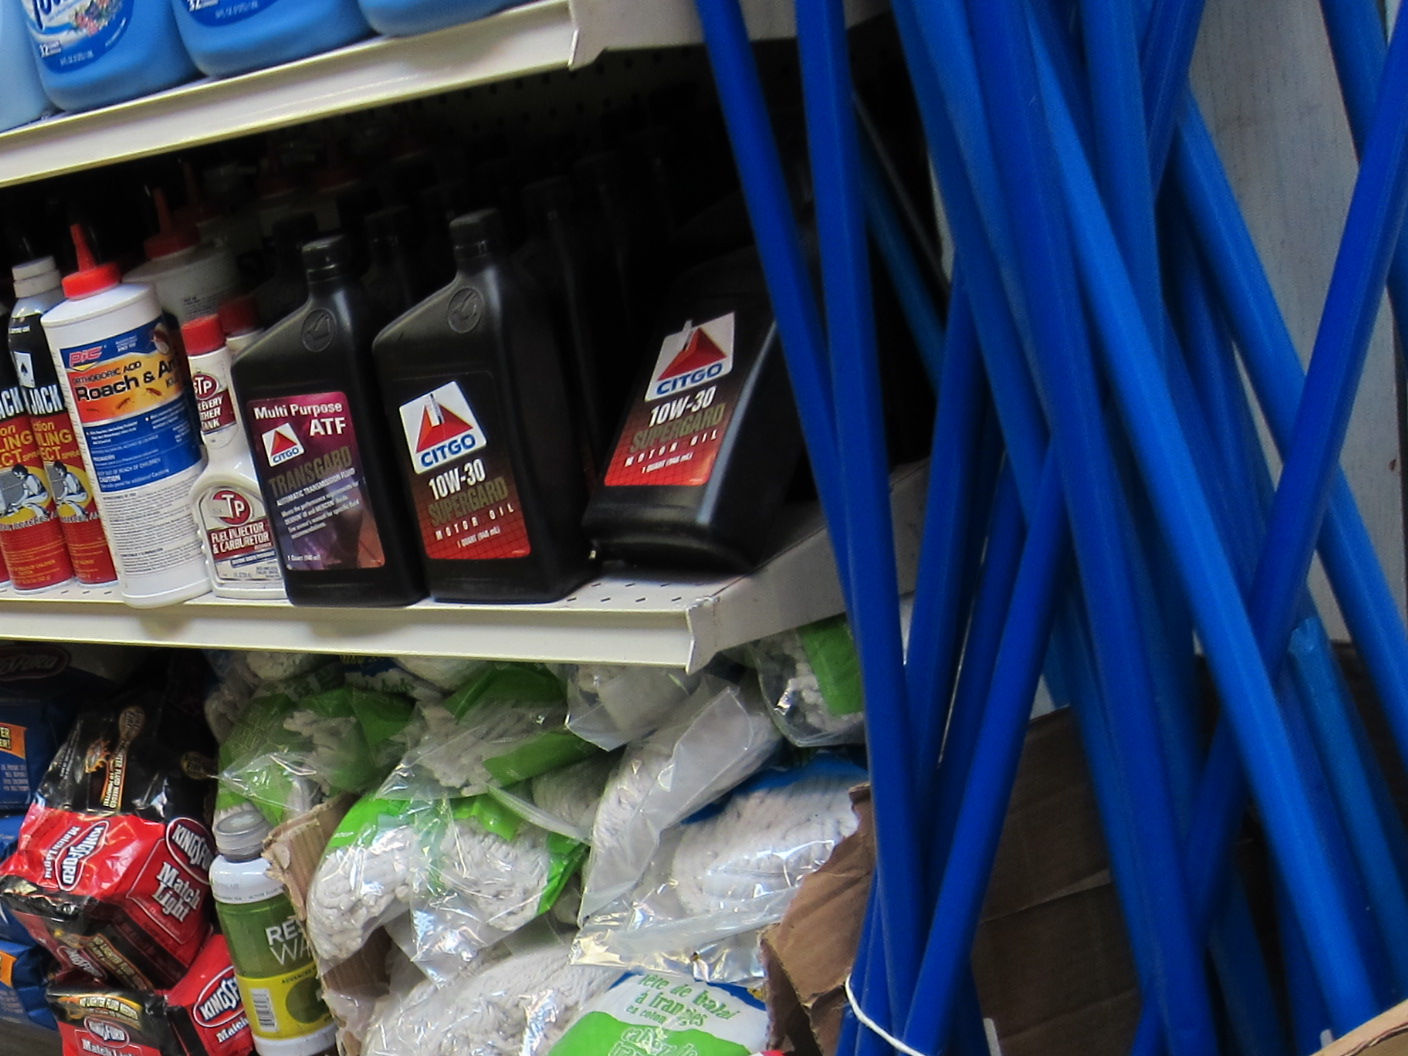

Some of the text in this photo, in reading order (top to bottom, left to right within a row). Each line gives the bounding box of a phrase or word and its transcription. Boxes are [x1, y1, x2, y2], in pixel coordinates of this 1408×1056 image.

[73, 360, 142, 385] ORTHOBORIC ACID
[75, 371, 156, 402] Roach &
[194, 376, 213, 396] STP
[656, 362, 724, 396] CITGO
[30, 384, 64, 415] JACK
[202, 395, 224, 411] EVERY
[254, 402, 343, 420] Multi Purpose
[648, 385, 718, 428] 10W-30
[33, 420, 55, 432] tion
[37, 429, 73, 445] LING
[309, 416, 347, 437] ATF
[629, 402, 727, 455] SUPERGARD
[272, 446, 301, 464] CITGO
[420, 433, 477, 468] CITGO
[624, 428, 719, 468] MOTOR OIL
[267, 445, 354, 497] TRANSGARD
[428, 458, 487, 501] 10W-30
[222, 493, 246, 519] TP
[427, 475, 510, 528] SUPERGARD
[211, 521, 266, 544] FUEL INJECTOR
[435, 502, 515, 542] MOTOR OIL
[212, 531, 271, 555] & CARBURETOR
[62, 826, 105, 886] KINGSFORD
[172, 823, 215, 871] KINGSFO
[156, 861, 202, 911] Match
[151, 883, 191, 923] Light
[199, 976, 242, 1022] KINGSF
[634, 991, 648, 1006] à
[670, 982, 693, 999] de
[693, 988, 742, 1021] balai
[638, 1008, 668, 1025] coton
